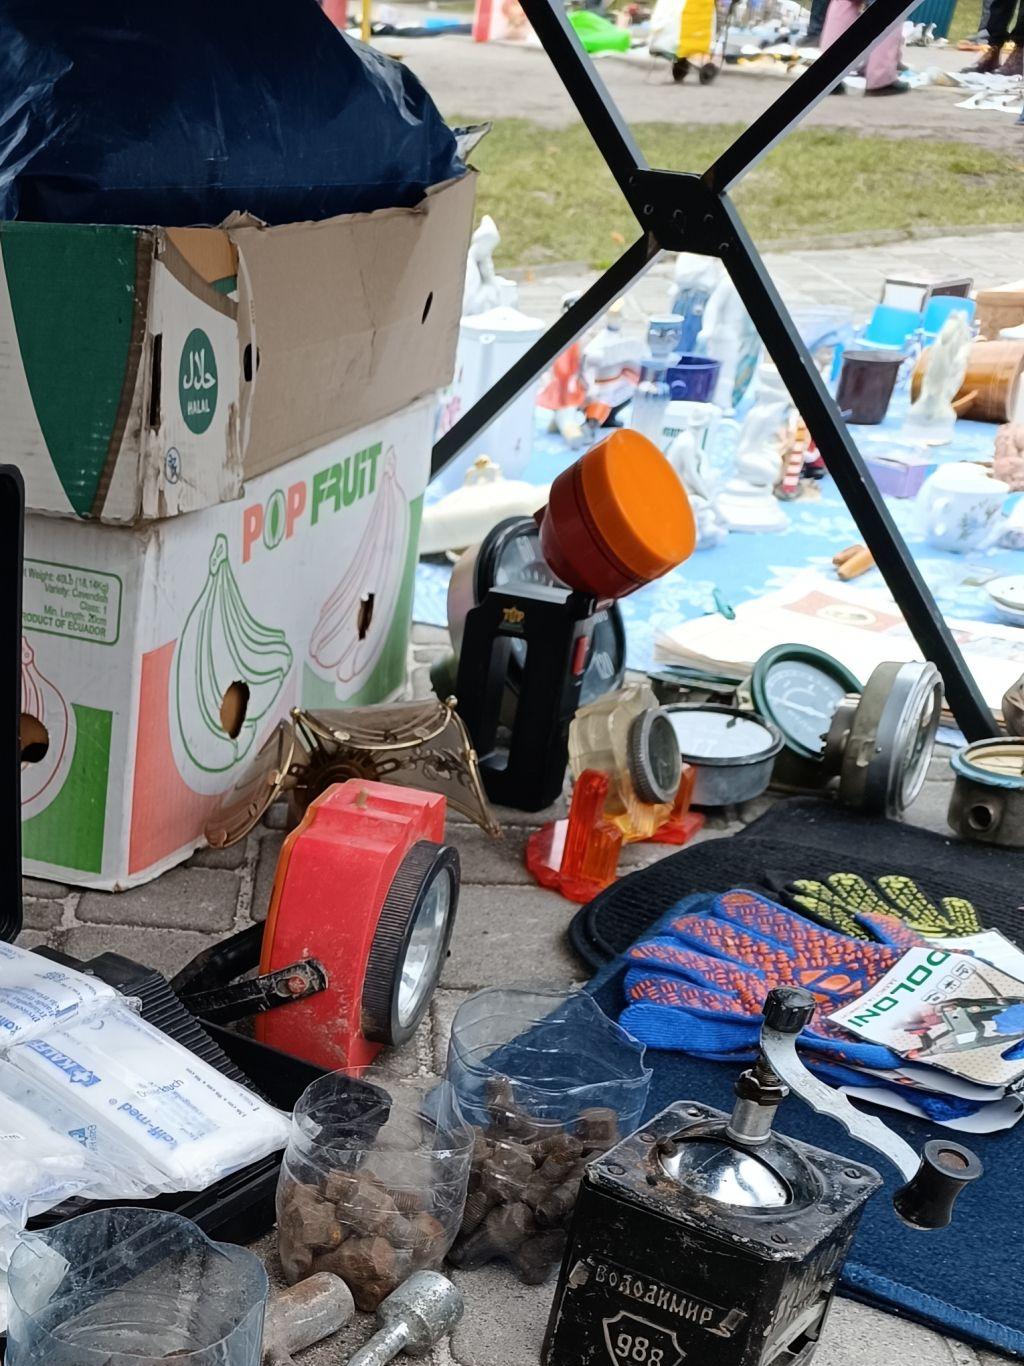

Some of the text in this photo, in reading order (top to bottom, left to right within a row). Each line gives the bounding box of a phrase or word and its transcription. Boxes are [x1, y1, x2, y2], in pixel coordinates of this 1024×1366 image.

[182, 348, 216, 390] حلال
[187, 399, 210, 416] HALAL
[242, 441, 383, 564] POP FRUIT
[22, 612, 106, 637] RODUCT OF ECUADOR
[848, 949, 951, 1028] DOLONI
